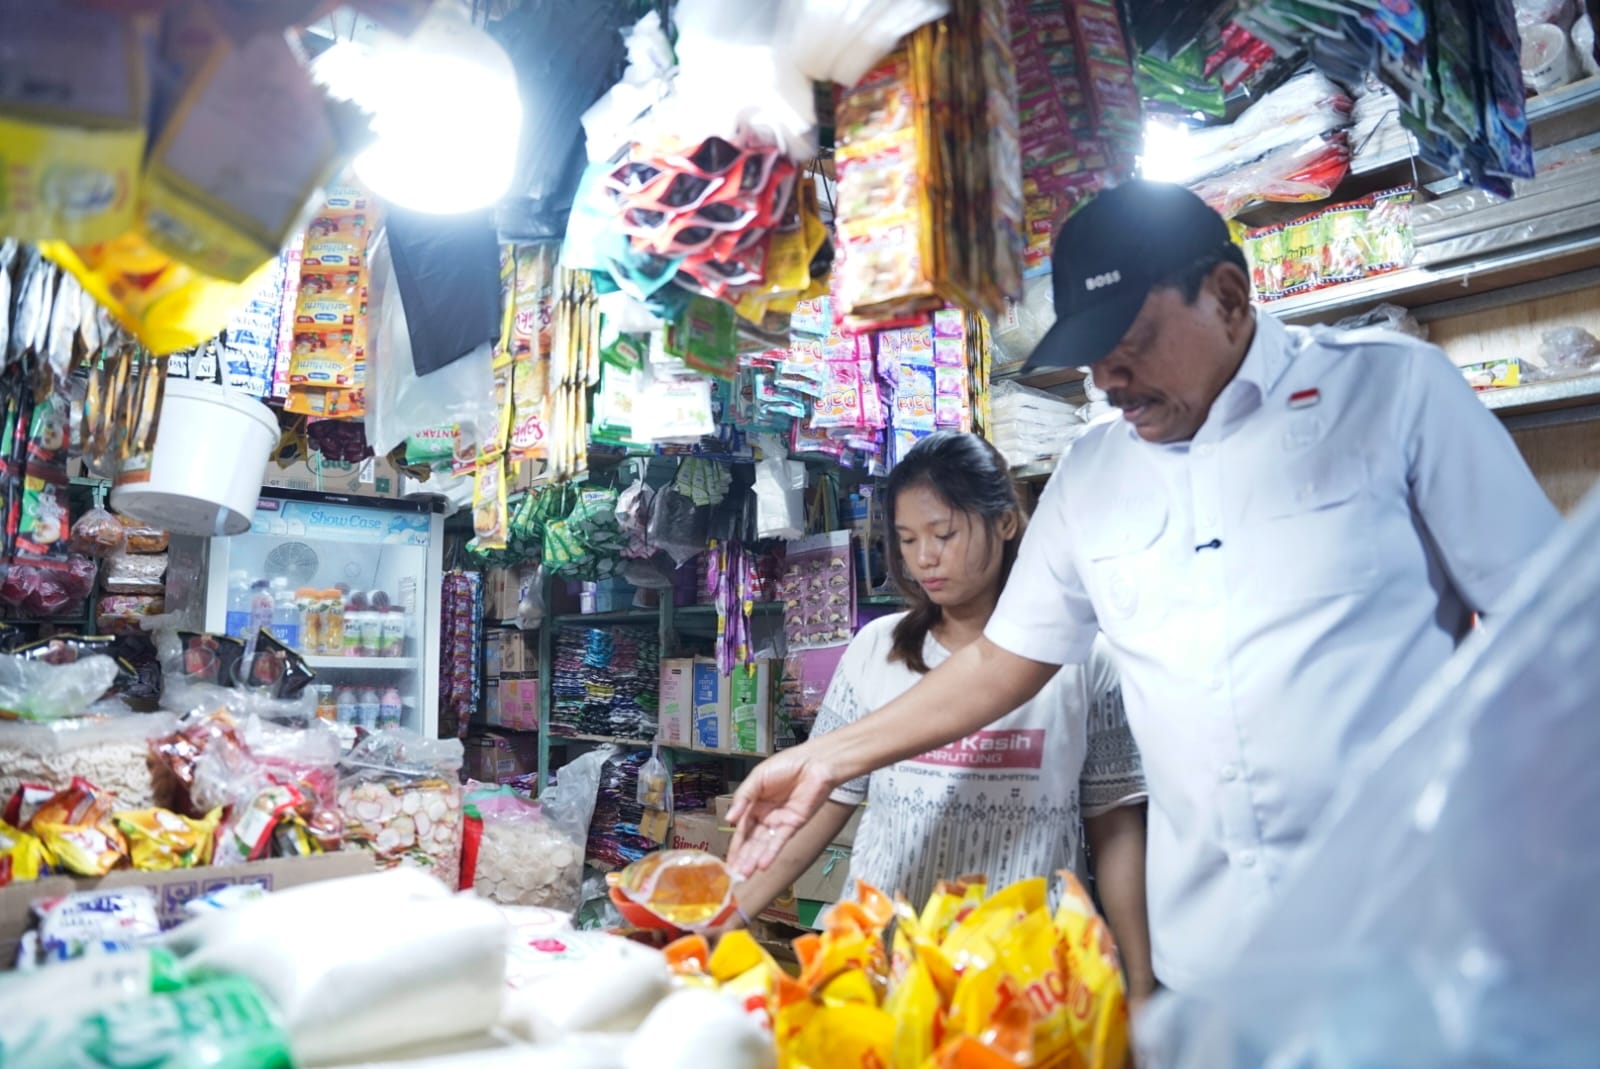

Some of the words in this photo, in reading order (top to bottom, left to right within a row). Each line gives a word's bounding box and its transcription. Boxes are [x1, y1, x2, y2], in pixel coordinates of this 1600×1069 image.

[1085, 269, 1121, 291] BOSS
[961, 734, 1032, 752] Kasih
[948, 771, 985, 781] NORTH
